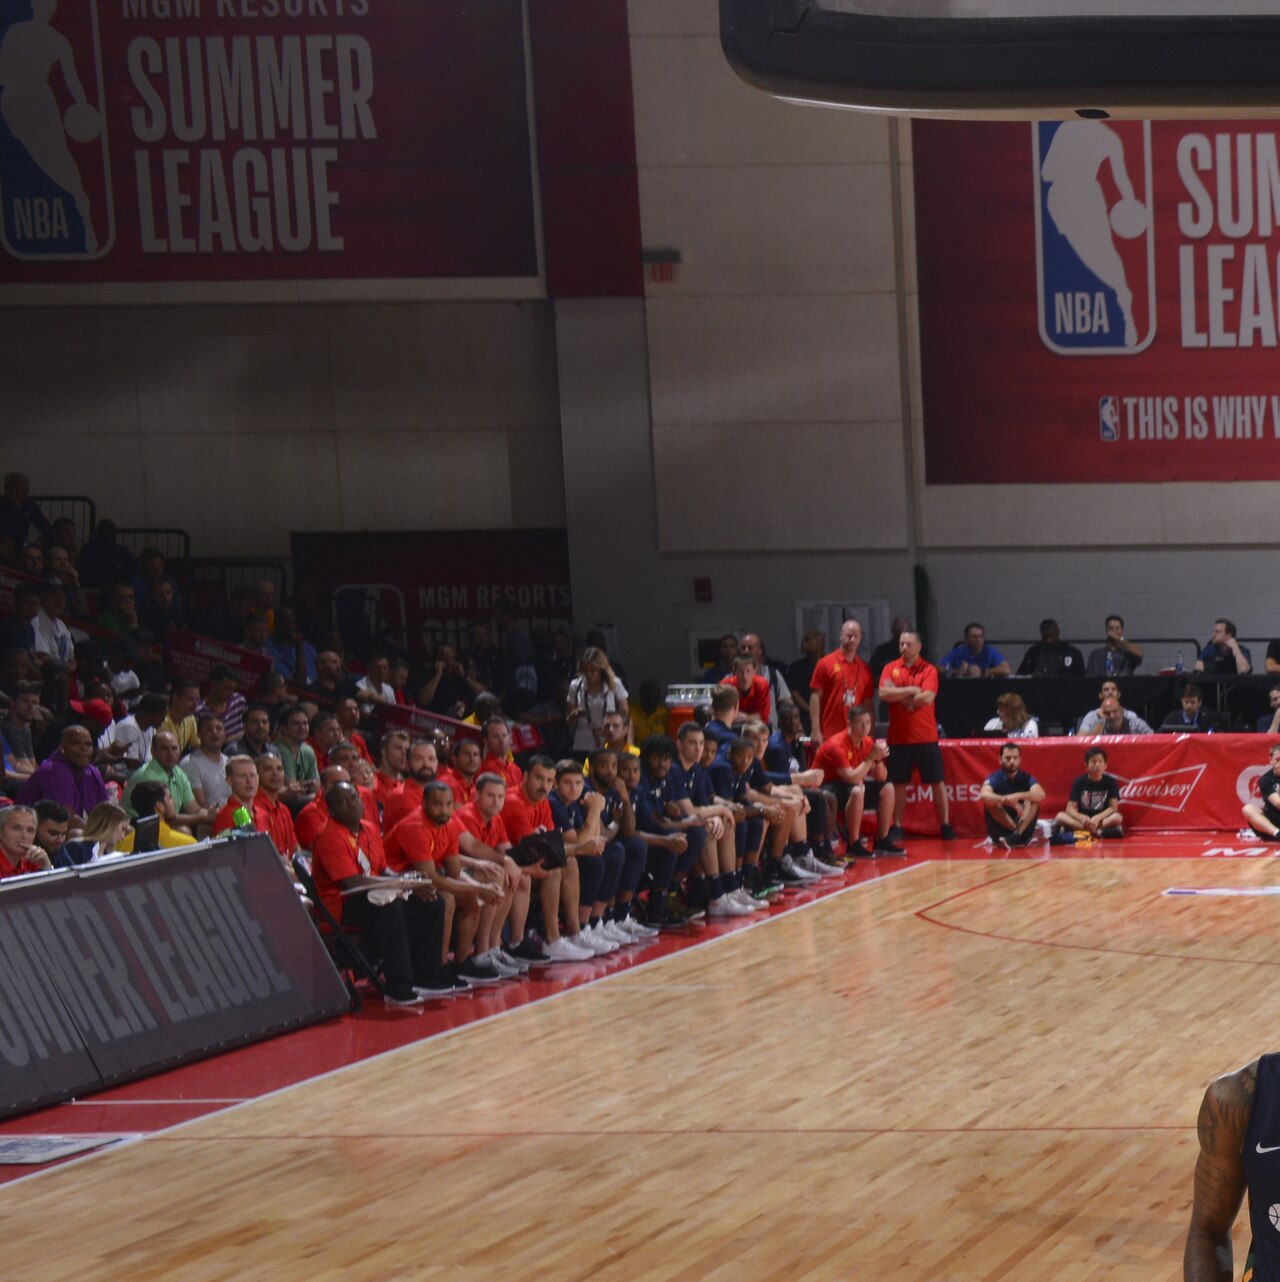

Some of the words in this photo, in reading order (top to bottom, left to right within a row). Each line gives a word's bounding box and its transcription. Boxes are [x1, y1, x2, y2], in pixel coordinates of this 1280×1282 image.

[127, 34, 378, 141] SUMMER
[13, 197, 70, 240] NBA
[134, 147, 345, 253] LEAGUE
[1054, 291, 1110, 334] NBA
[1123, 398, 1178, 440] THIS
[1184, 398, 1209, 439] IS
[1213, 396, 1266, 439] WHY
[419, 586, 468, 609] MGM
[104, 865, 293, 1024] LEAGUE
